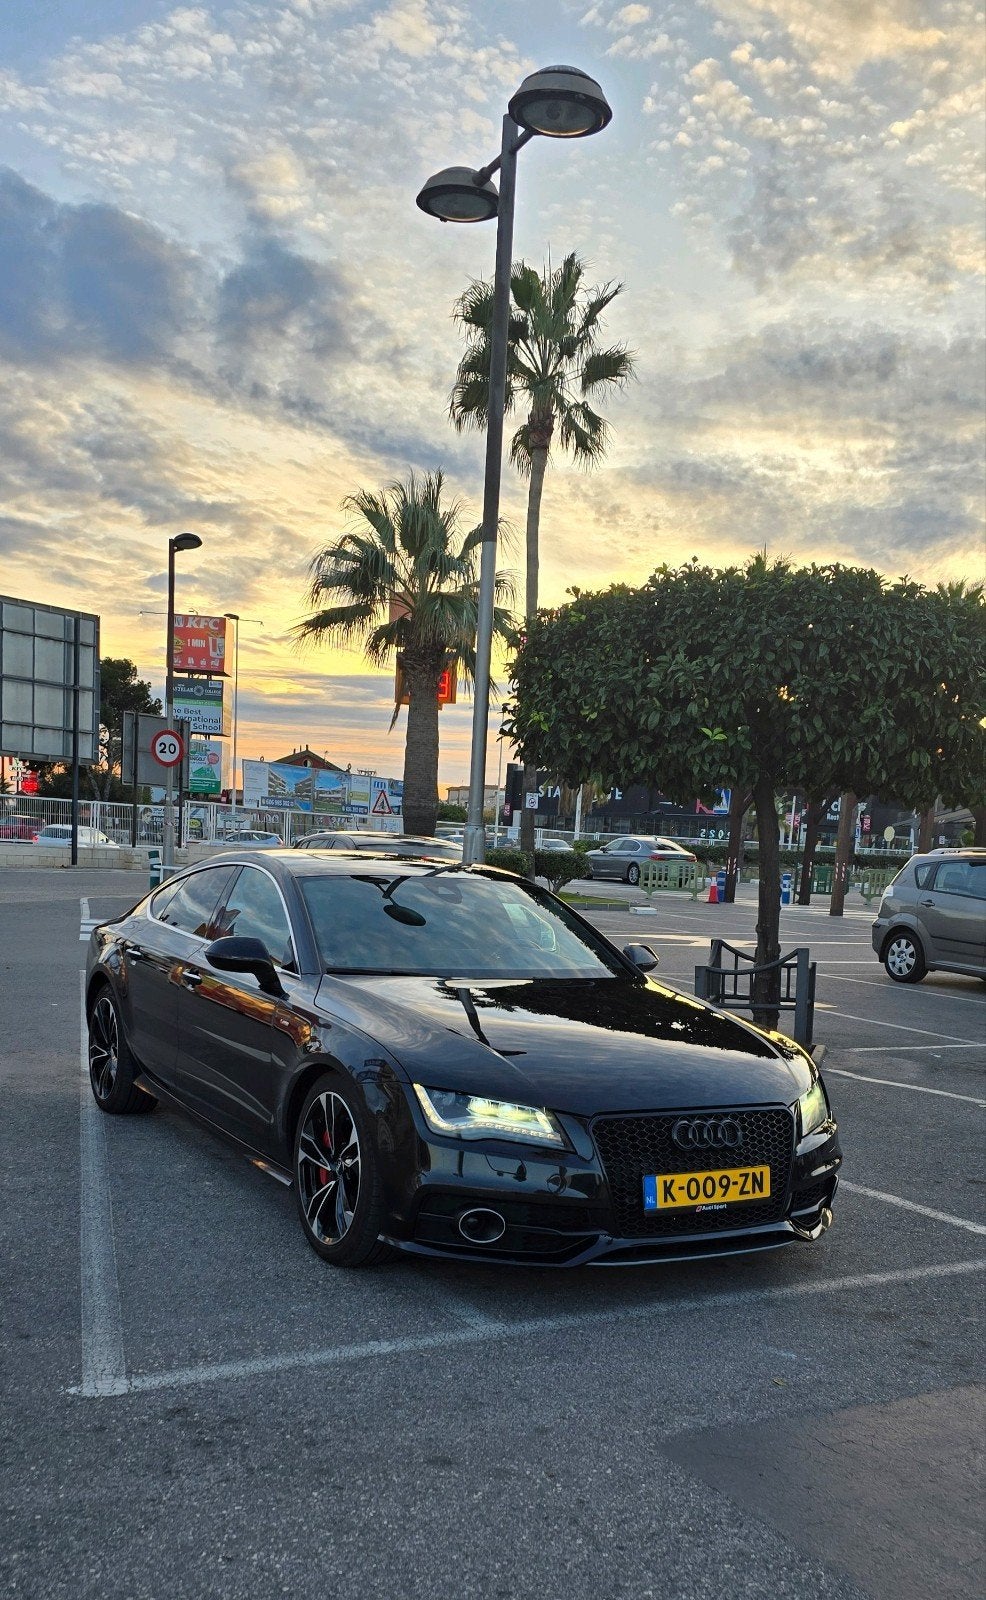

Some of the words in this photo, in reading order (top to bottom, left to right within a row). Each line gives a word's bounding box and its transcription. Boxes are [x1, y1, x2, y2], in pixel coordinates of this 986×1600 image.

[186, 616, 220, 630] KFC
[192, 638, 206, 648] MIN
[175, 715, 221, 724] ternational
[193, 722, 221, 731] School
[159, 742, 177, 755] 20
[646, 1196, 656, 1204] NL
[663, 1170, 764, 1203] K-009-ZN
